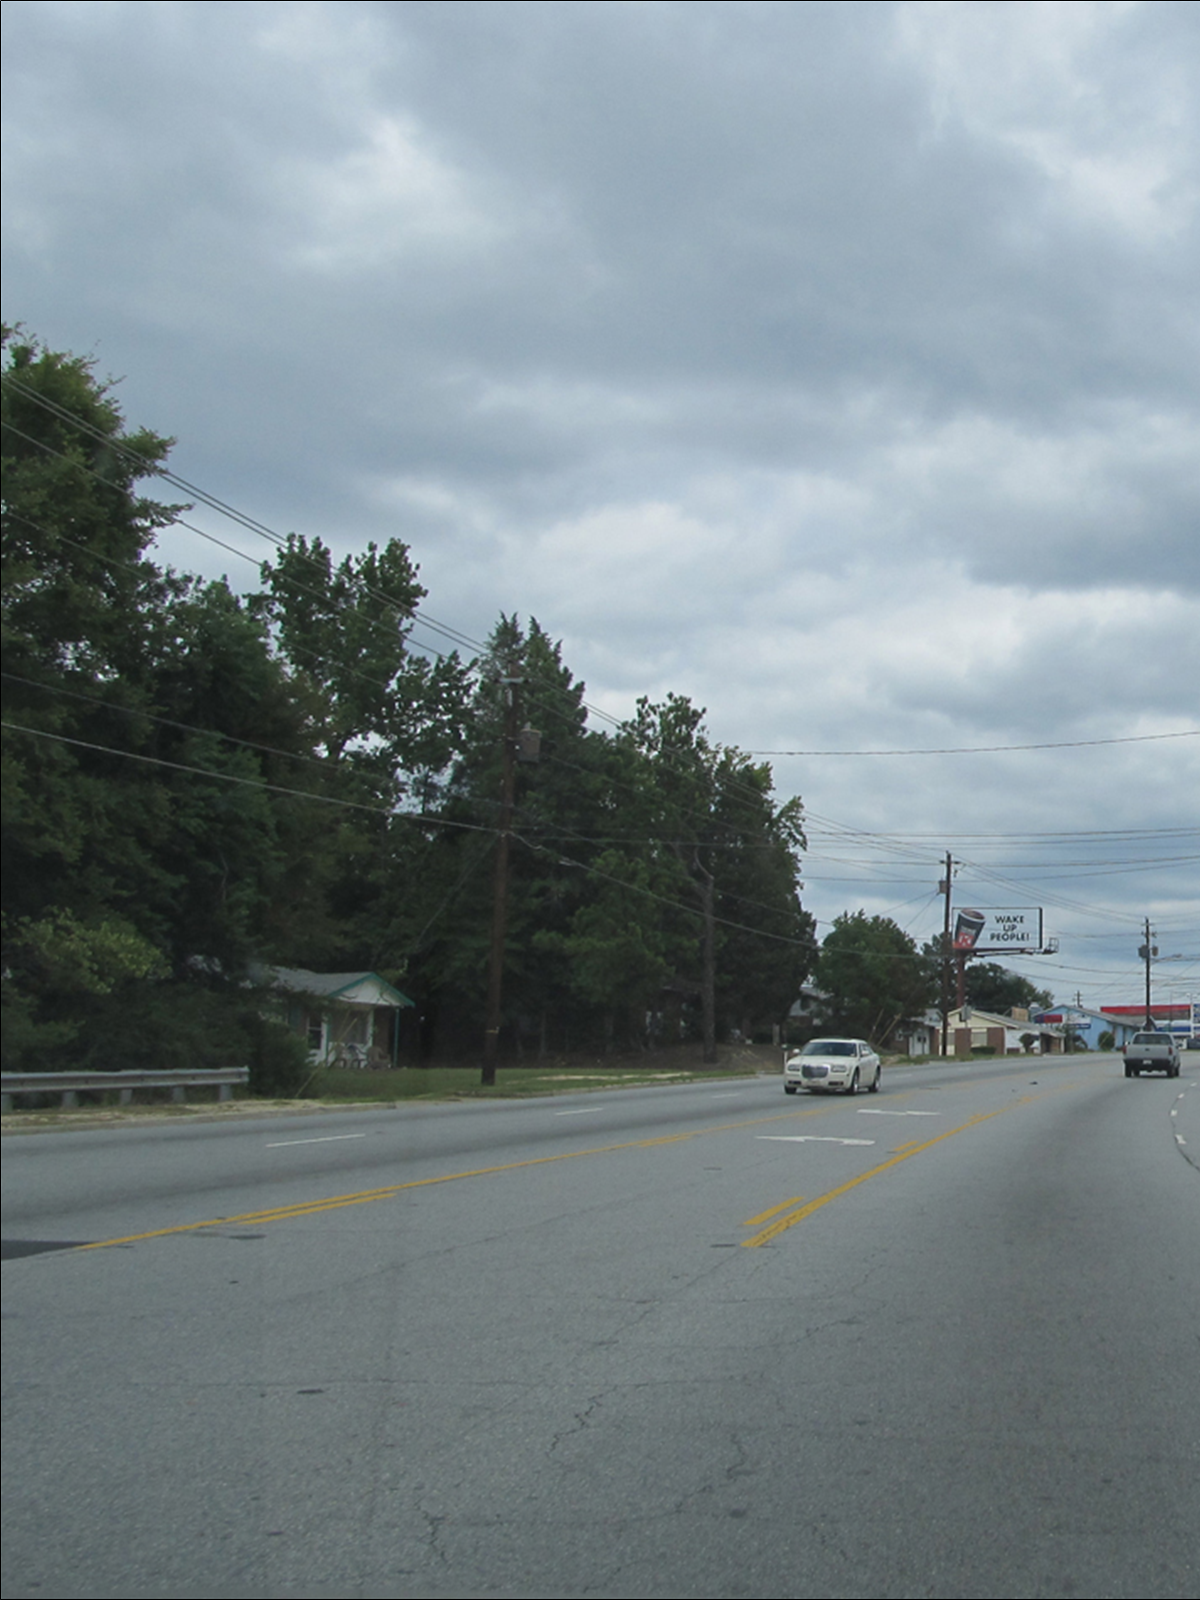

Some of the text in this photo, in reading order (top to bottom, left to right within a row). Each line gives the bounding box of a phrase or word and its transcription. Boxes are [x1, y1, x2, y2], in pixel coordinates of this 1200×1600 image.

[995, 915, 1025, 924] WAKE
[1002, 924, 1018, 932] UP
[990, 932, 1030, 942] PEOPLE!
